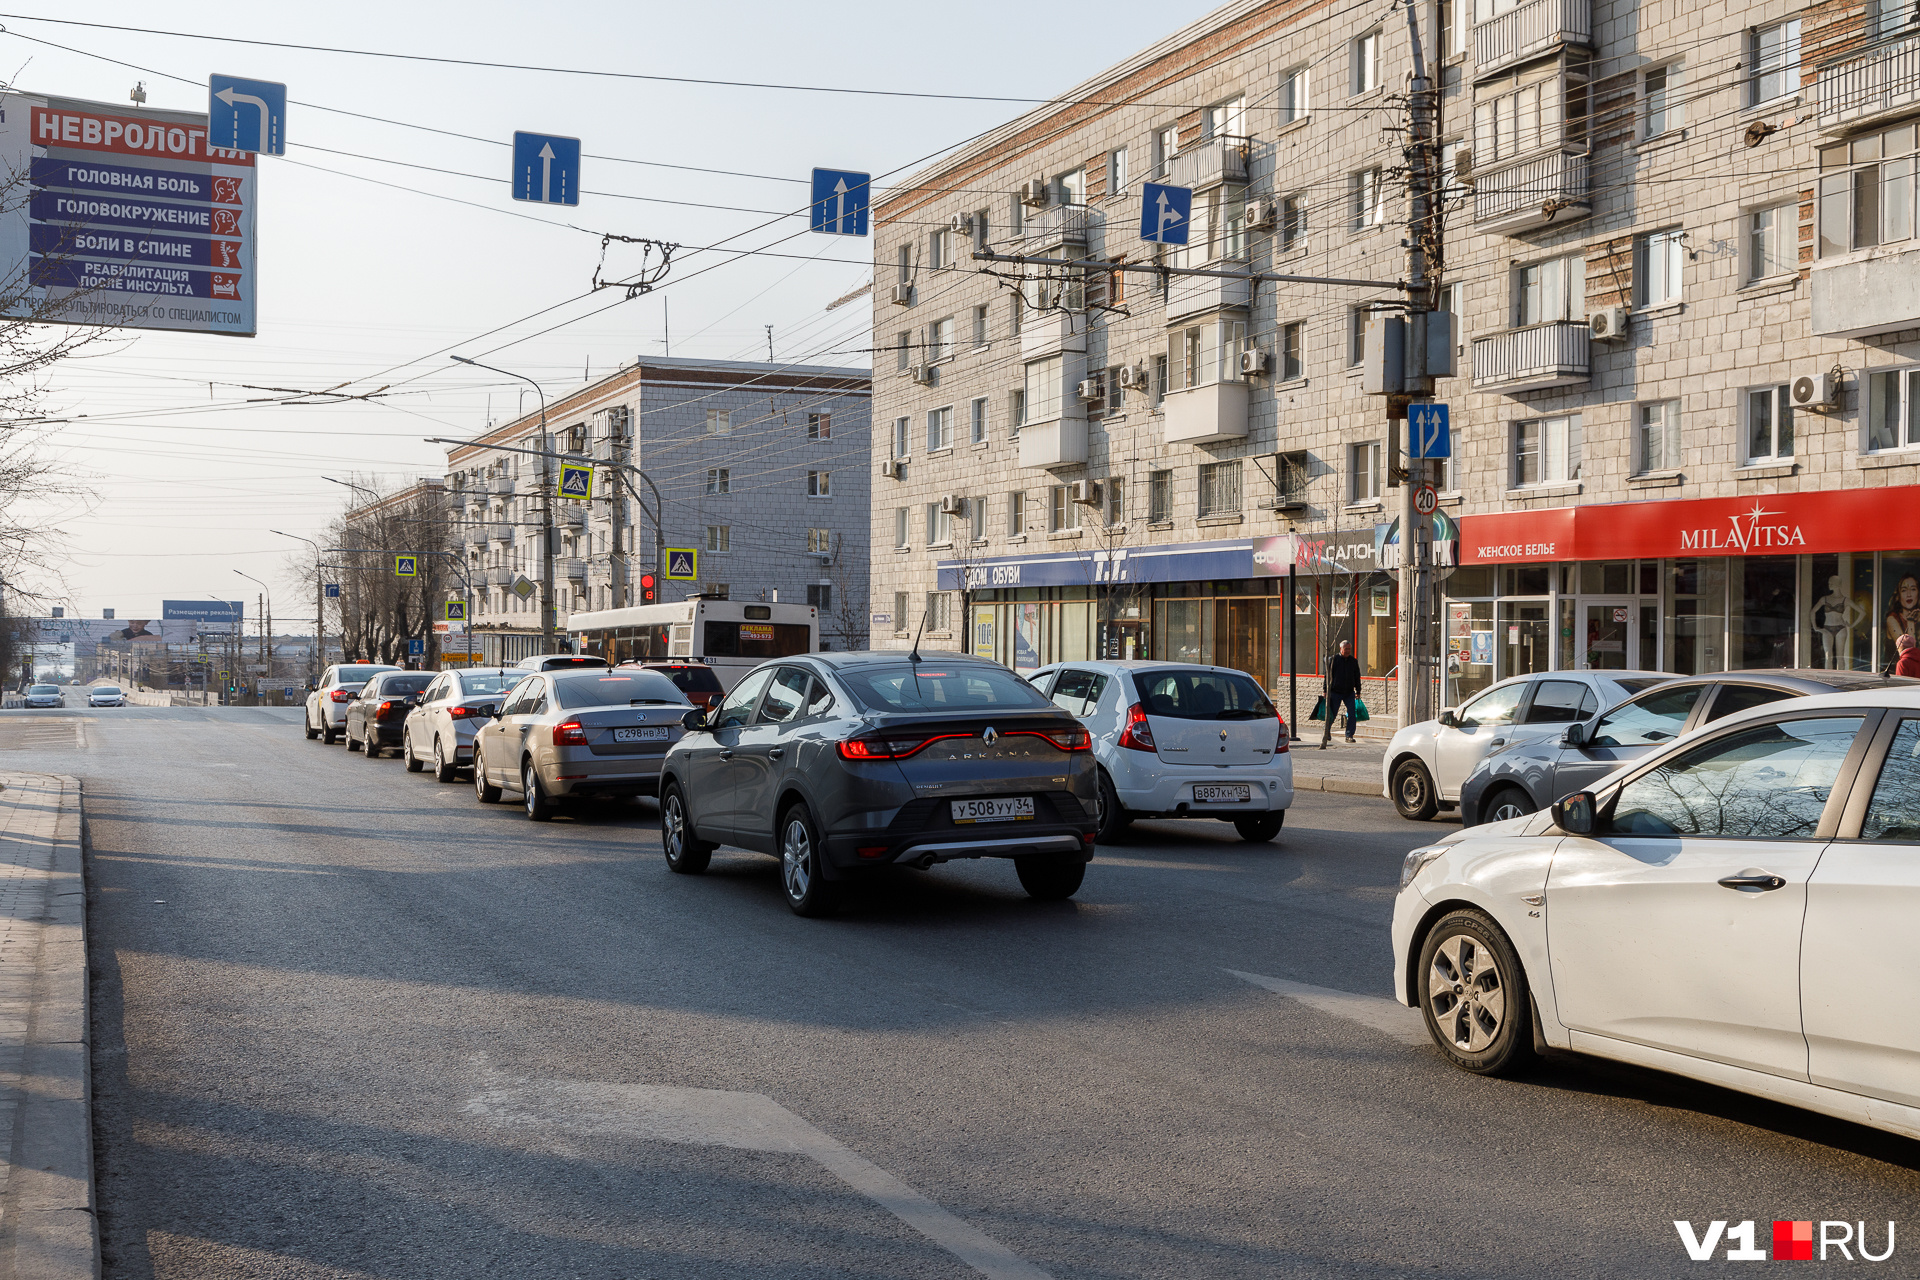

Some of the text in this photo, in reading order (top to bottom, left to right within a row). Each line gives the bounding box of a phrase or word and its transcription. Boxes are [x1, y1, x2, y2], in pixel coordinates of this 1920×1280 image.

[68, 167, 200, 193] ГОЛОВНАЯ БОЛЬ
[57, 199, 210, 226] ГОЛОВОКРУЖЕНИЕ
[75, 235, 192, 258] БОЛИ В СПИНЕ
[85, 262, 189, 282] РЕАБИЛИТАЦИЯ
[80, 275, 194, 296] ПОСЛЕ ИНСУЛЬТА
[153, 302, 165, 318] СО
[169, 303, 242, 325] СПЕЦИАЛИСТОМ
[1418, 492, 1433, 509] 20
[1681, 516, 1806, 553] MILAVITSA
[1296, 540, 1325, 568] АРТ
[1477, 542, 1555, 559] ЖЕНСКОЕ БЕЛЬЕ
[970, 565, 1020, 589] ДОМ ОБУВИ
[168, 608, 238, 618] Размещение рекламы
[949, 750, 1030, 760] ARKANA
[1233, 786, 1247, 796] 134
[1016, 797, 1029, 811] 34
[1464, 920, 1494, 942] CP661
